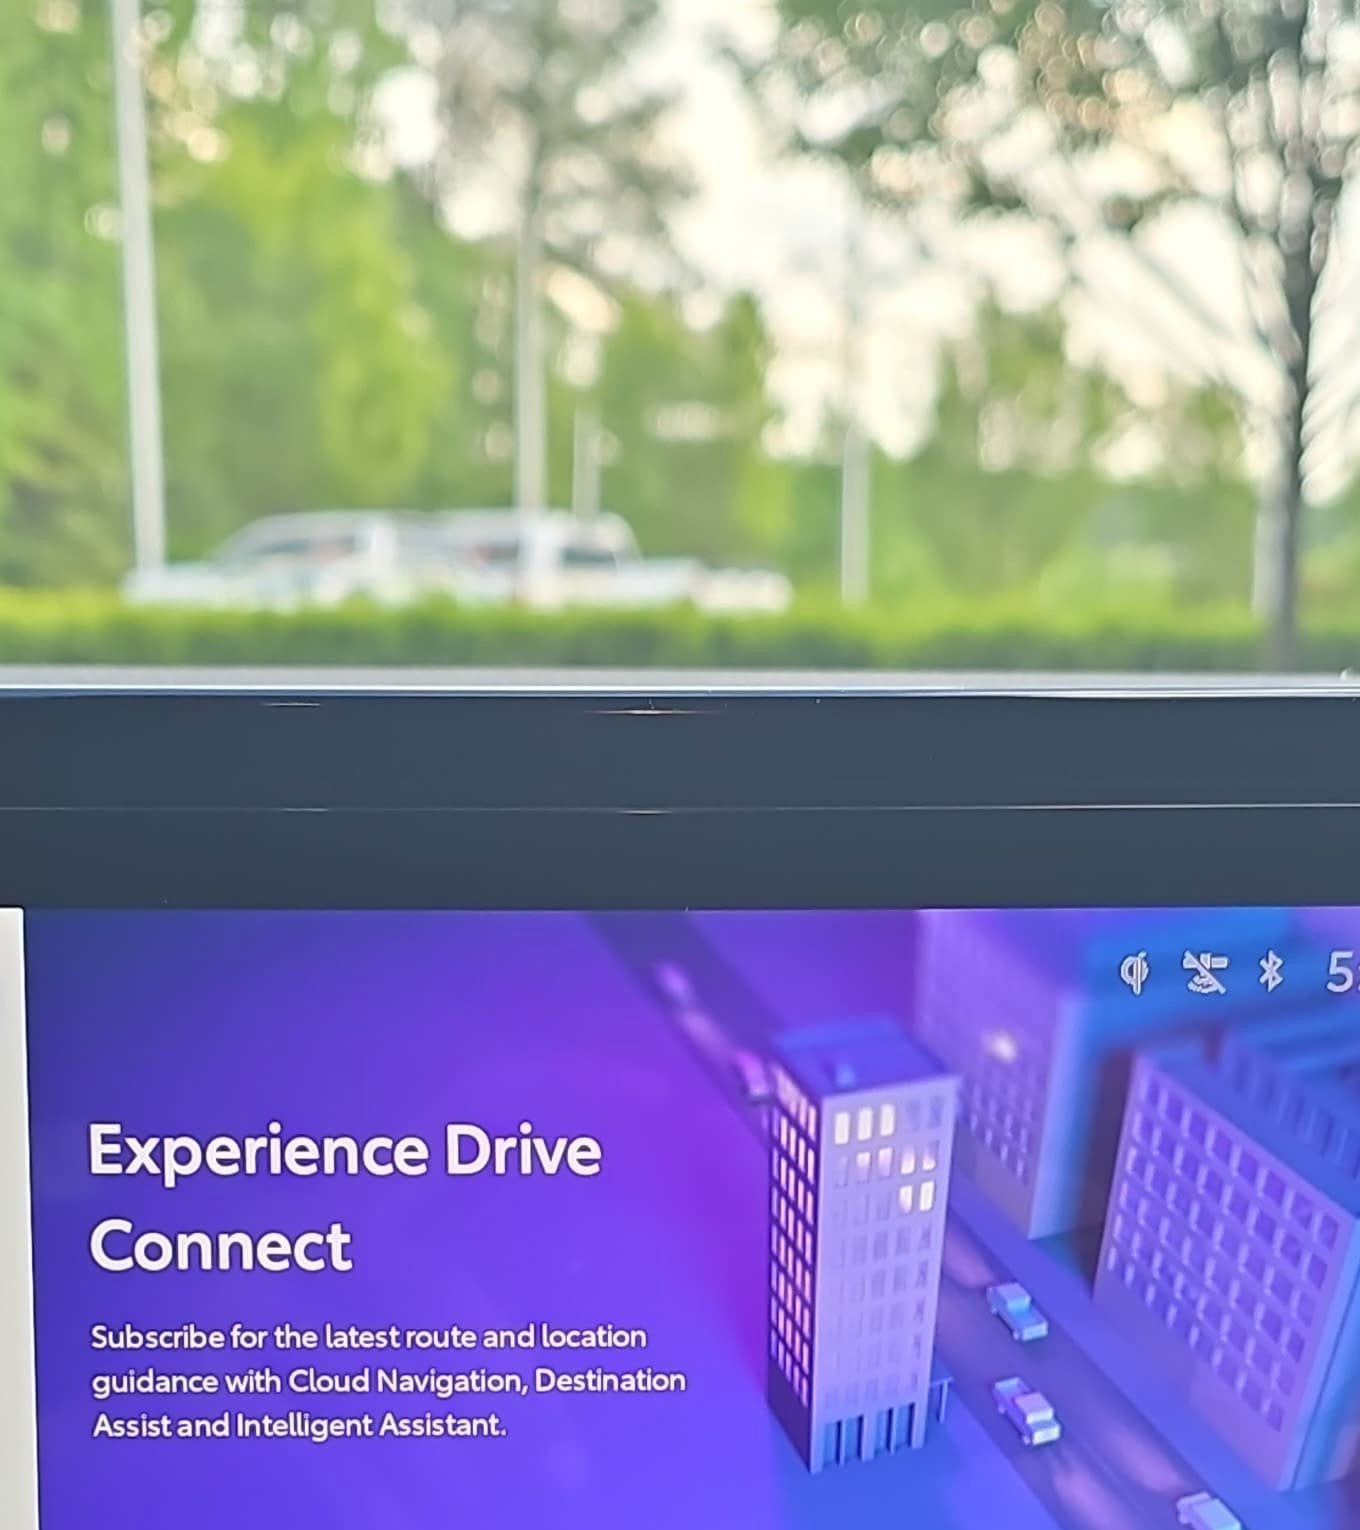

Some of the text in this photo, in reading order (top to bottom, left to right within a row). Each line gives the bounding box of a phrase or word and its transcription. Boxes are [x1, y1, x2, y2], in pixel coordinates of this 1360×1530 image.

[89, 1121, 603, 1188] Experience Drive
[90, 1219, 354, 1272] Connect
[91, 1324, 648, 1350] Subscribe for the latest route and location
[92, 1368, 687, 1401] guidance with Cloud Navigation, Destination
[93, 1412, 507, 1443] Assist and Intelligent Assistant.
